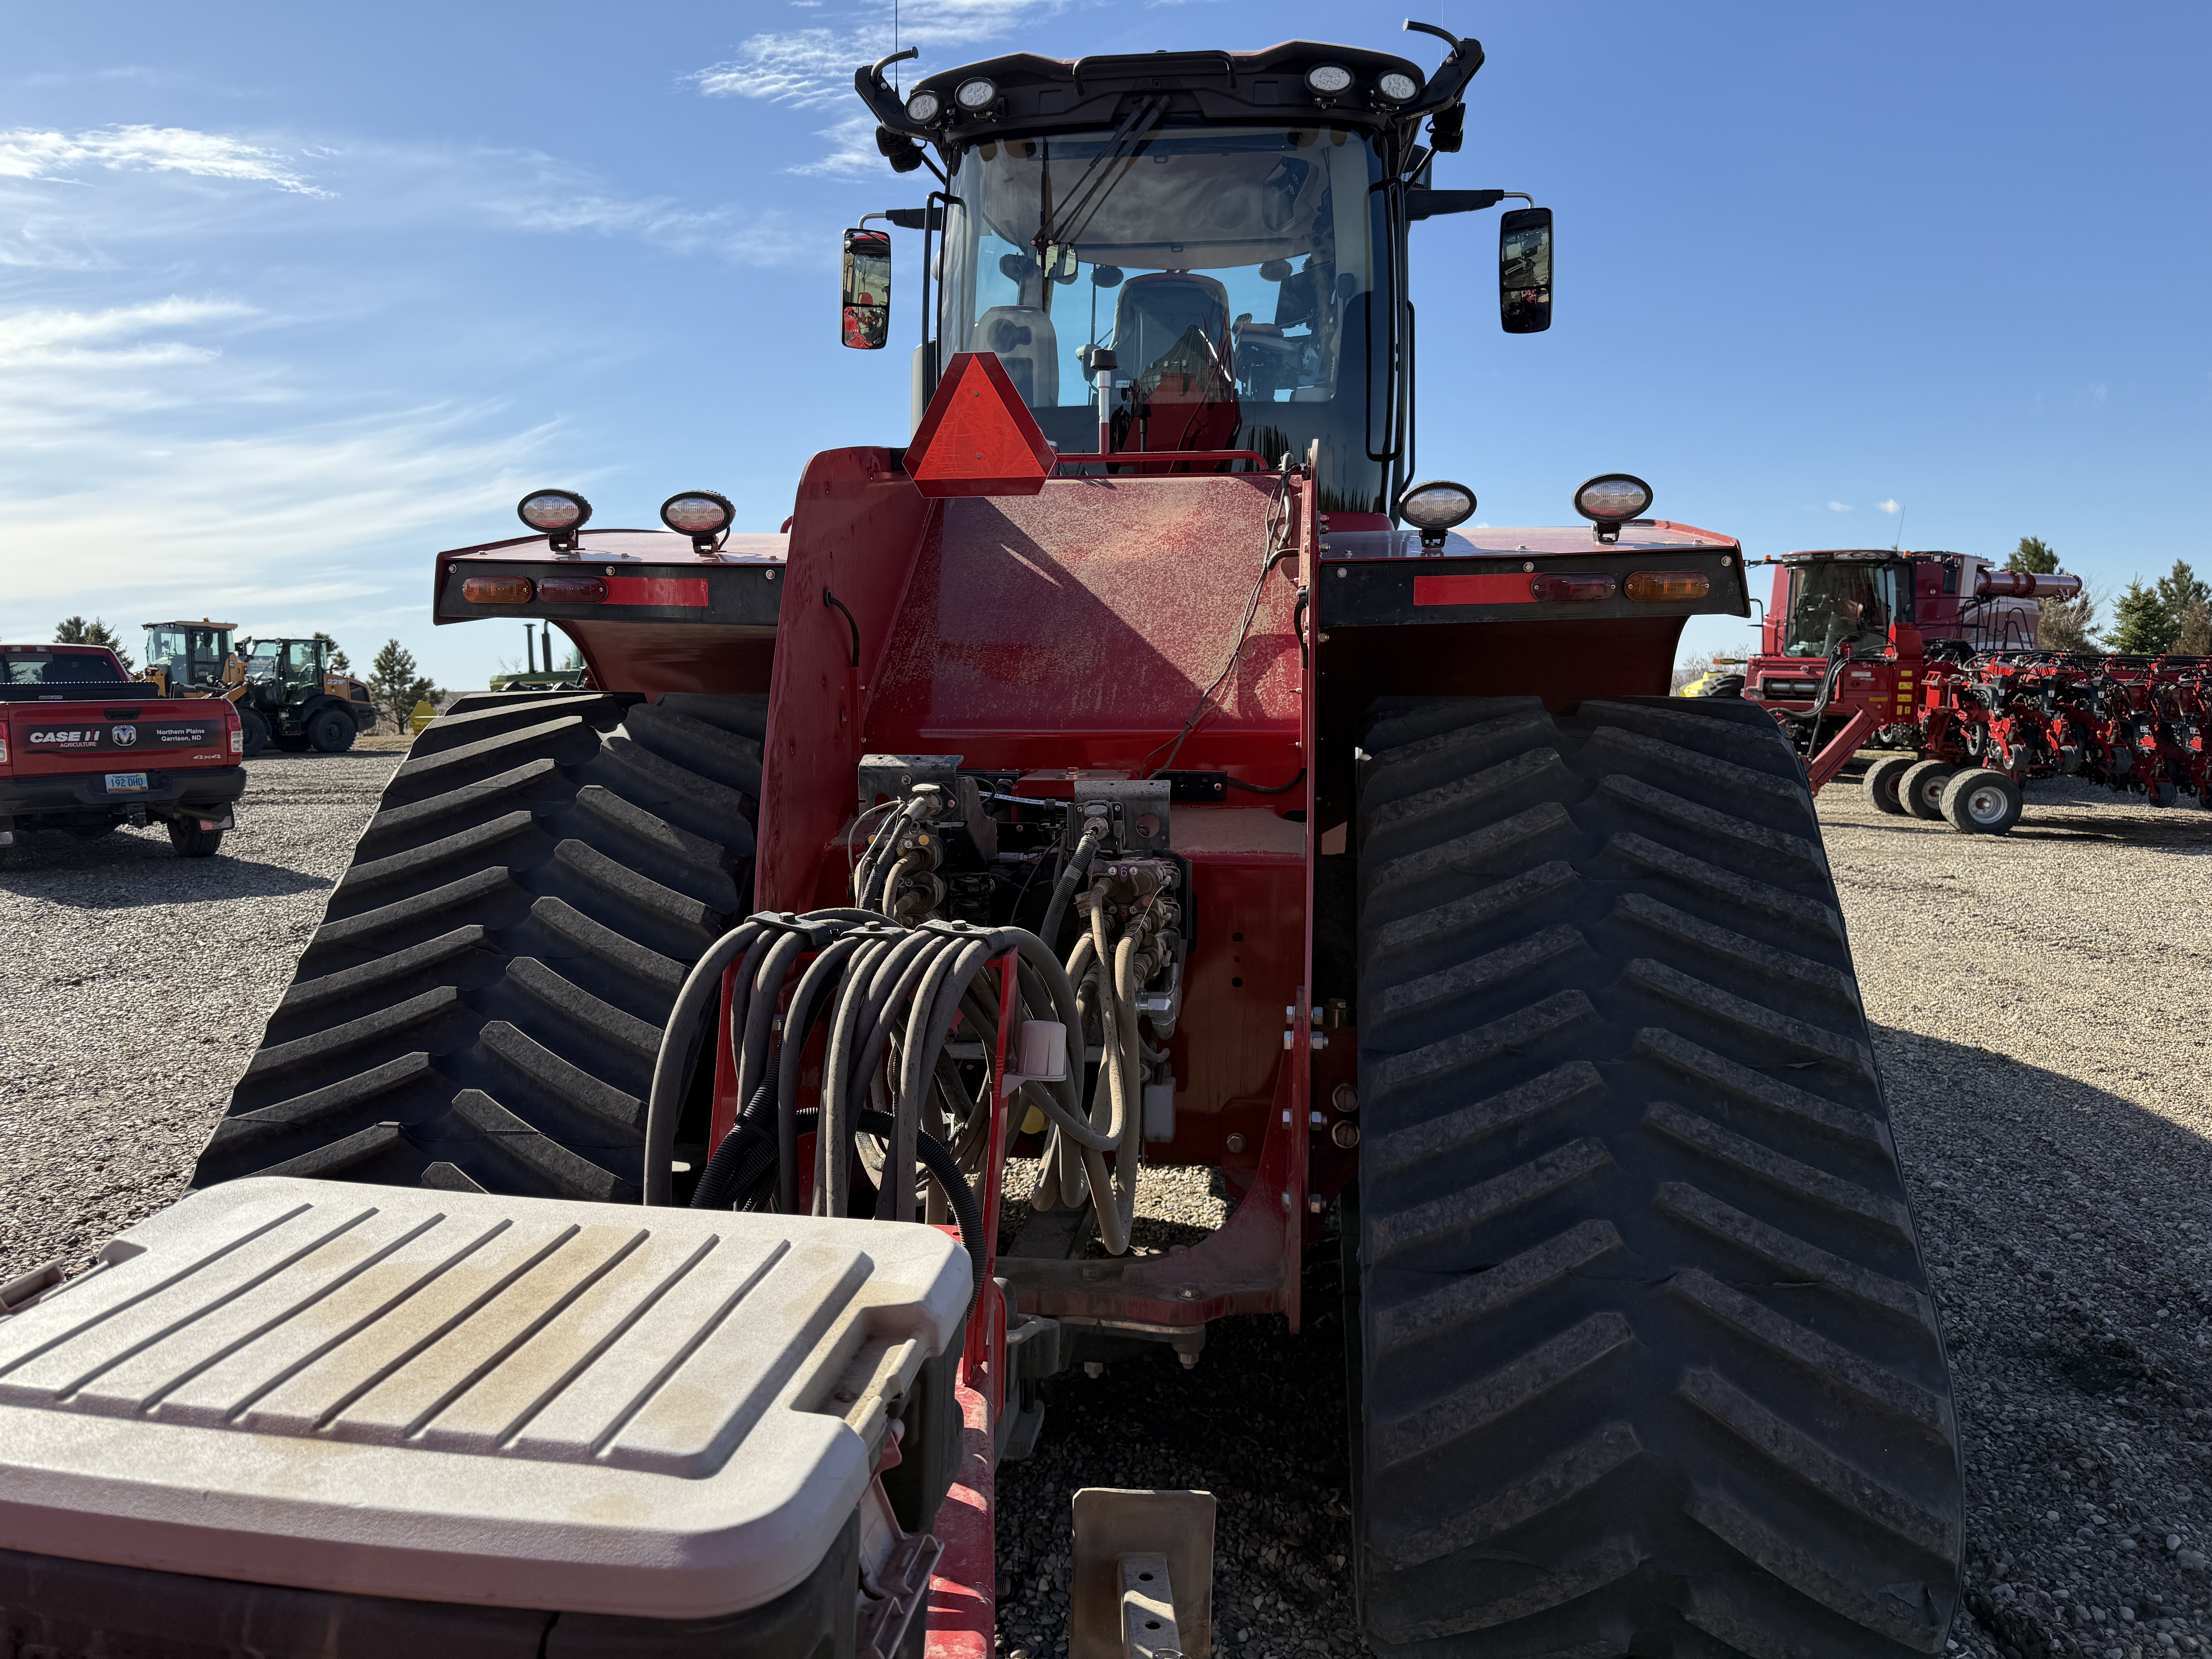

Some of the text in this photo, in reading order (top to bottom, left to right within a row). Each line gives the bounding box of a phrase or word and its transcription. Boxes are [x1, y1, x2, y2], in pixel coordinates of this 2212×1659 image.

[30, 729, 100, 743] CASE IH
[111, 778, 143, 787] 192 DHD
[897, 840, 903, 850] 3
[1120, 867, 1127, 877] 6
[898, 878, 904, 887] 2
[1121, 907, 1127, 916] 5
